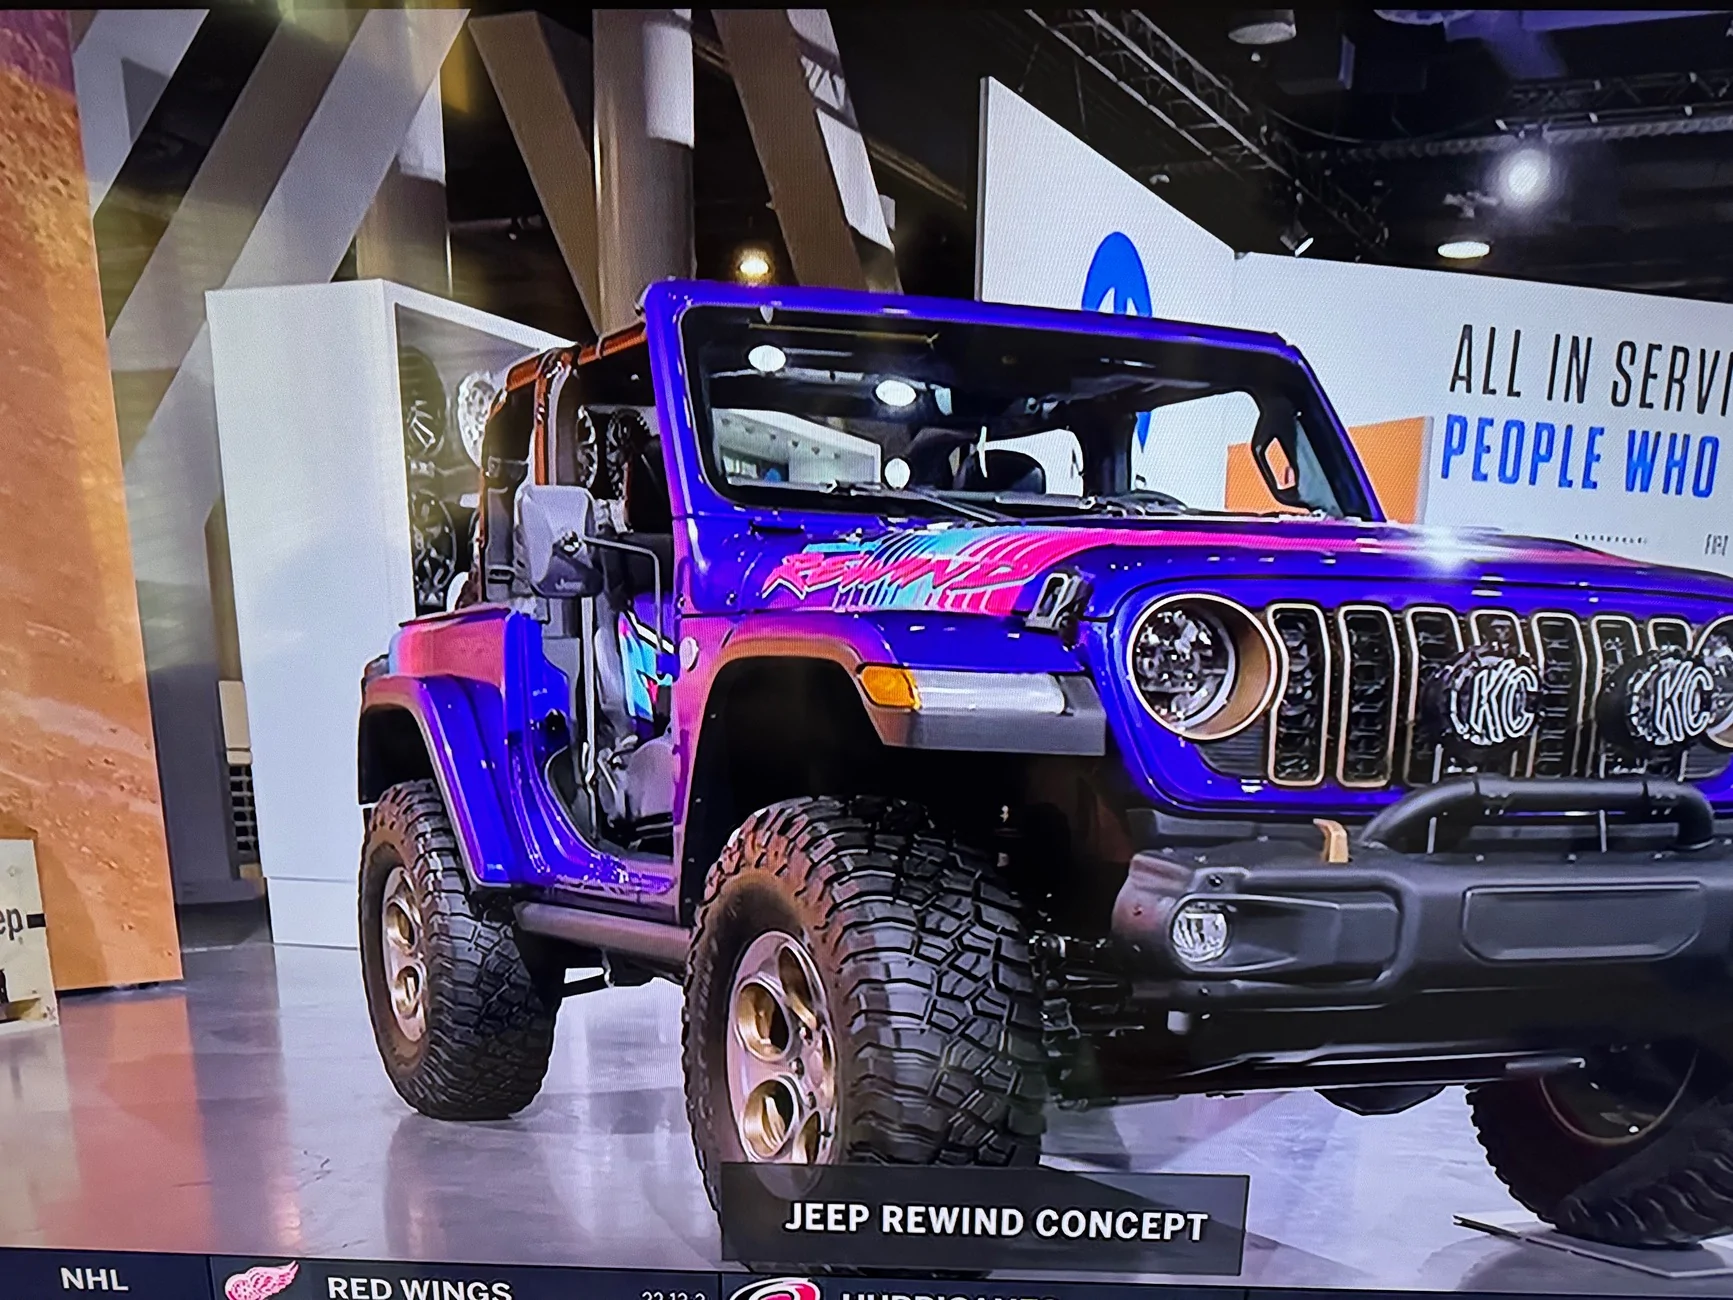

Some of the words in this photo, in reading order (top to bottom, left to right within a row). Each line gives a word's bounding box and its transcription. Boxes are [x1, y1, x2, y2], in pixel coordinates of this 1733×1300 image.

[1449, 324, 1521, 398] ALL
[1547, 333, 1592, 404] IN
[1611, 340, 1733, 417] SERVI
[1441, 413, 1605, 490] PEOPLE
[1625, 429, 1720, 498] WHO
[1470, 658, 1539, 743] KC
[1656, 660, 1713, 742] KC
[785, 1202, 869, 1233] JEEP
[881, 1205, 1024, 1237] REWIND
[1036, 1209, 1208, 1242] CONCEPT
[60, 1266, 129, 1291] NHL
[327, 1276, 393, 1300] RED
[399, 1279, 513, 1300] WINGS
